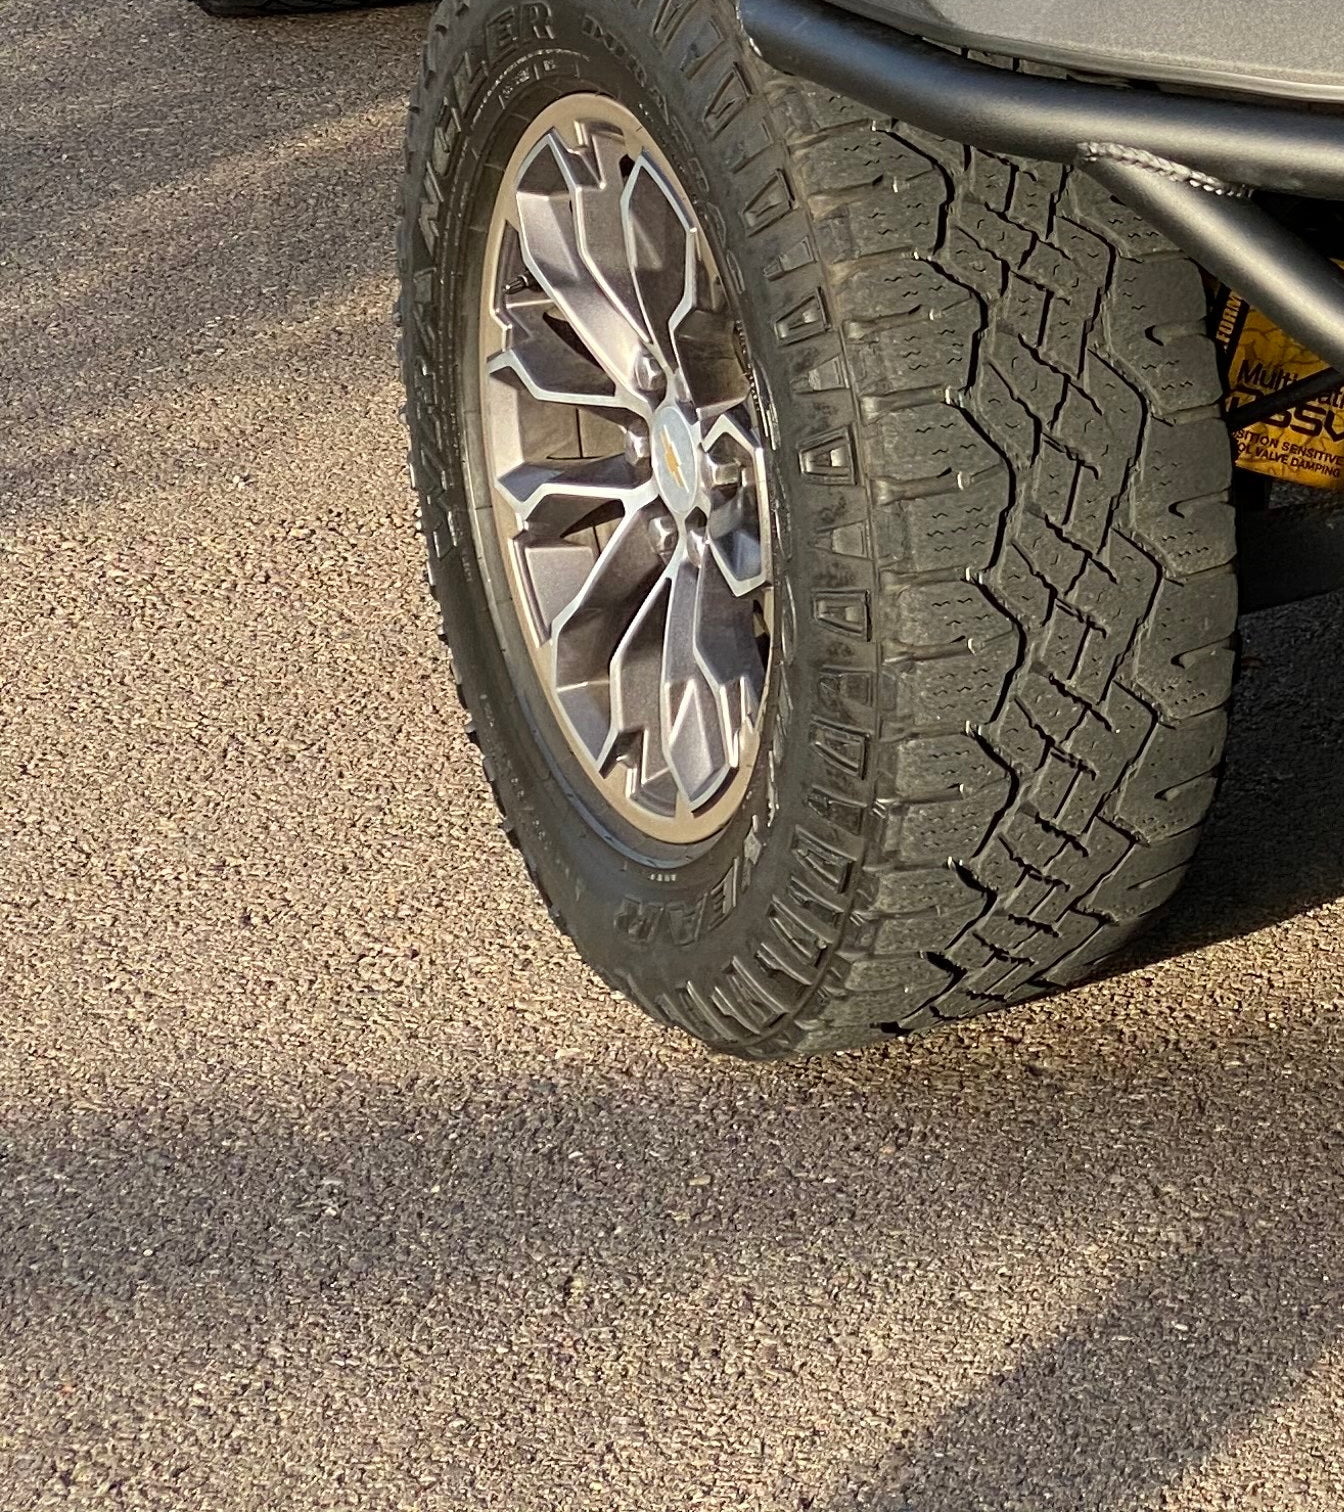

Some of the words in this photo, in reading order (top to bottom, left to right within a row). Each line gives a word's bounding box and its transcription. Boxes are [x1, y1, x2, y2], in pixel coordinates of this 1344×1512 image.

[1233, 429, 1280, 449] SITION
[1281, 441, 1344, 466] SENSITIVE
[1254, 446, 1289, 465] VALVE
[1289, 456, 1341, 478] DAMPING
